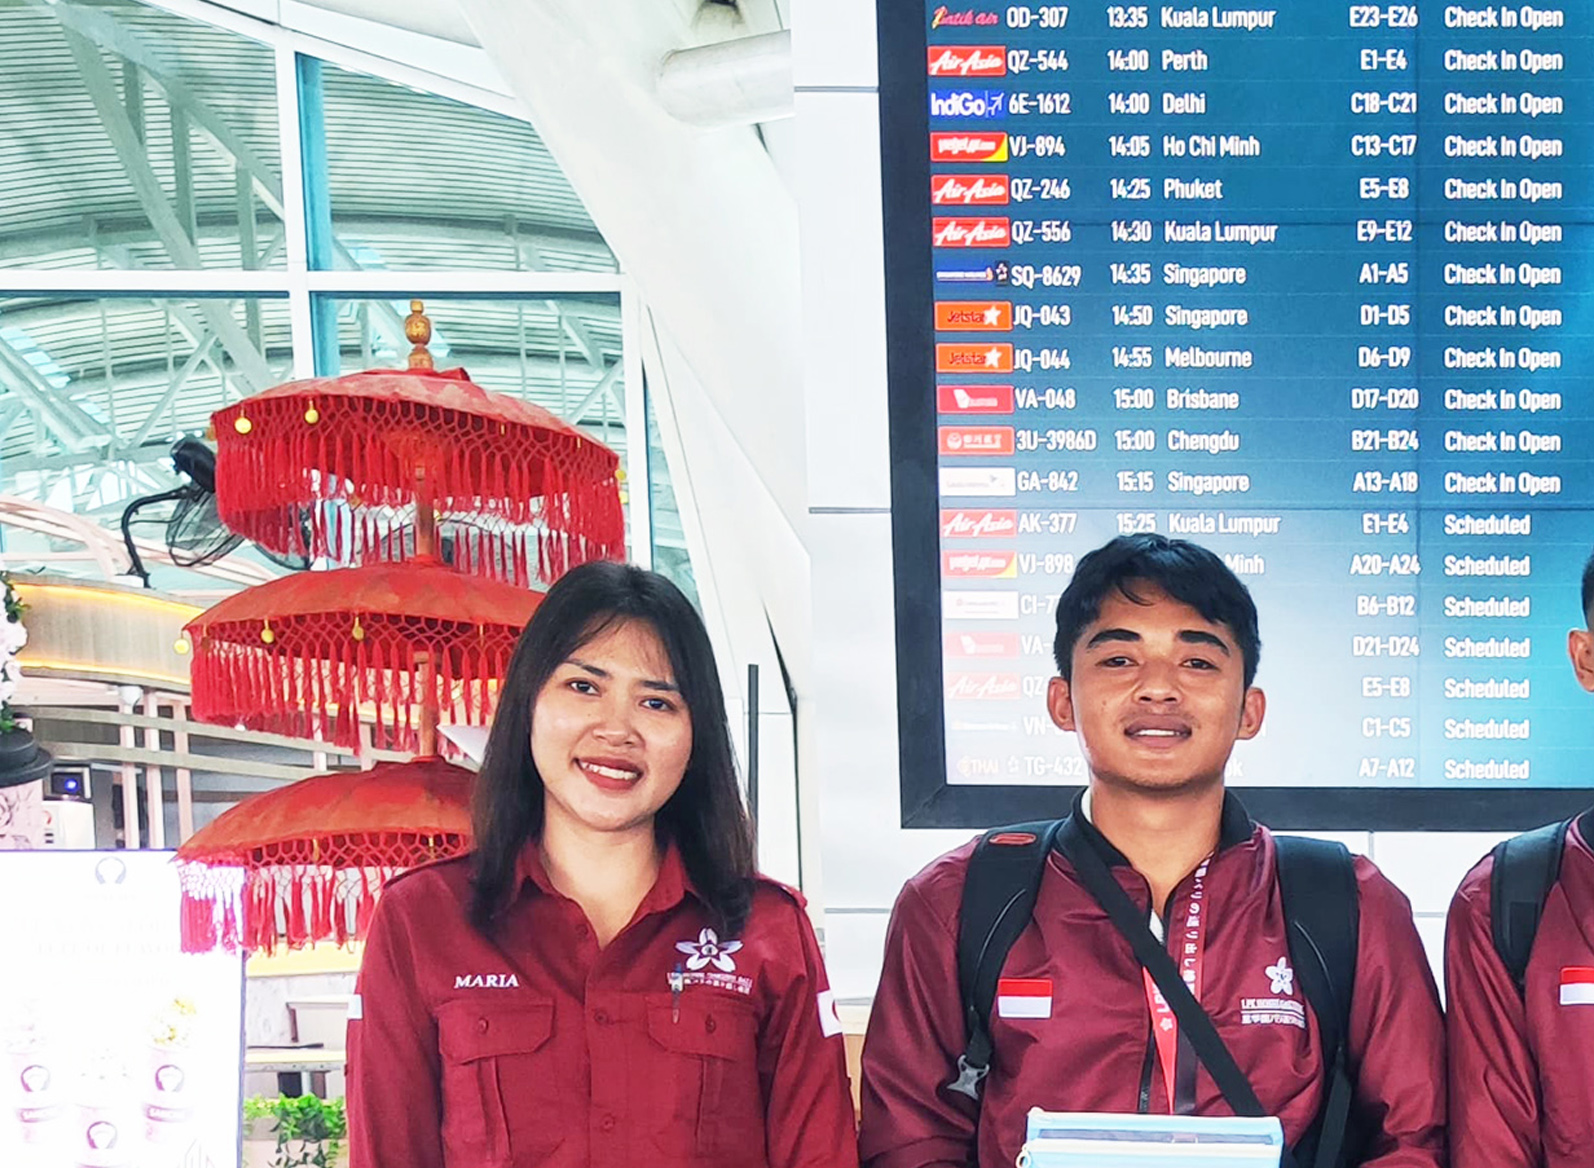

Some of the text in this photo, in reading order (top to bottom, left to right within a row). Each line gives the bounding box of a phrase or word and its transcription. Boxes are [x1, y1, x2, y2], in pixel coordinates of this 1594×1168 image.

[1006, 6, 1069, 28] OD-307
[1106, 6, 1148, 28] 13:35
[1160, 6, 1277, 31] Kuala Lumpur
[1349, 5, 1419, 28] E23-E26
[1444, 5, 1564, 31] Check In Open
[1007, 49, 1069, 74] QZ-544
[1107, 49, 1149, 71] 14:00
[1161, 49, 1208, 71] Perth
[1360, 48, 1408, 71] E1-E4
[931, 92, 985, 116] IndiGo
[1008, 92, 1071, 115] 6E-1612
[1108, 92, 1150, 115] 14:00
[1162, 92, 1206, 114] Delhi
[1350, 91, 1418, 114] C18-C21
[1444, 92, 1564, 118] Check In Open
[1008, 135, 1066, 157] VJ-894
[1108, 135, 1151, 157] 14:05
[1162, 134, 1261, 157] Ho Chi Minh
[1351, 134, 1418, 157] C13-C17
[1010, 178, 1071, 202] QZ-246
[1109, 177, 1151, 200] 14:25
[1163, 178, 1223, 200] Phuket
[1359, 177, 1410, 199] E5-E8
[1011, 220, 1072, 245] QZ-556
[1111, 220, 1152, 242] 14:30
[1164, 220, 1279, 245] Kuala Lumpur
[1356, 219, 1413, 242] E9-E12
[1444, 220, 1563, 246] Check In Open
[1010, 265, 1082, 289] SQ-8629
[1109, 262, 1152, 285] 14:35
[1163, 262, 1247, 288] Singapore
[1359, 262, 1409, 284] A1-A5
[1012, 304, 1071, 329] JQ-043
[1111, 304, 1153, 326] 14:50
[1165, 304, 1249, 330] Singapore
[1360, 304, 1411, 326] D1-D5
[1012, 348, 1071, 373] JQ-044
[1111, 346, 1153, 368] 14:55
[1164, 346, 1253, 368] Melbourne
[1358, 346, 1411, 368] D6-D9
[1014, 388, 1076, 409] VA-048
[1113, 388, 1155, 409] 15:00
[1166, 388, 1240, 410] Brisbane
[1351, 388, 1420, 409] D17-D20
[1444, 388, 1562, 413] Check In Open
[1016, 429, 1097, 451] 3U-3986D
[1114, 429, 1156, 451] 15:00
[1167, 429, 1240, 455] Chengdu
[1351, 429, 1420, 451] B21-B24
[1017, 470, 1079, 492] GA-842
[1116, 470, 1154, 492] 15:15
[1167, 470, 1251, 496] Singapore
[1352, 471, 1419, 493] A13-A18
[1018, 512, 1078, 534] AK-377
[1116, 511, 1157, 533] 15:25
[1168, 512, 1281, 537] Kuala Lumpur
[1362, 512, 1410, 534] E1-E4
[1444, 513, 1531, 535] Scheduled
[453, 973, 520, 990] MARIA
